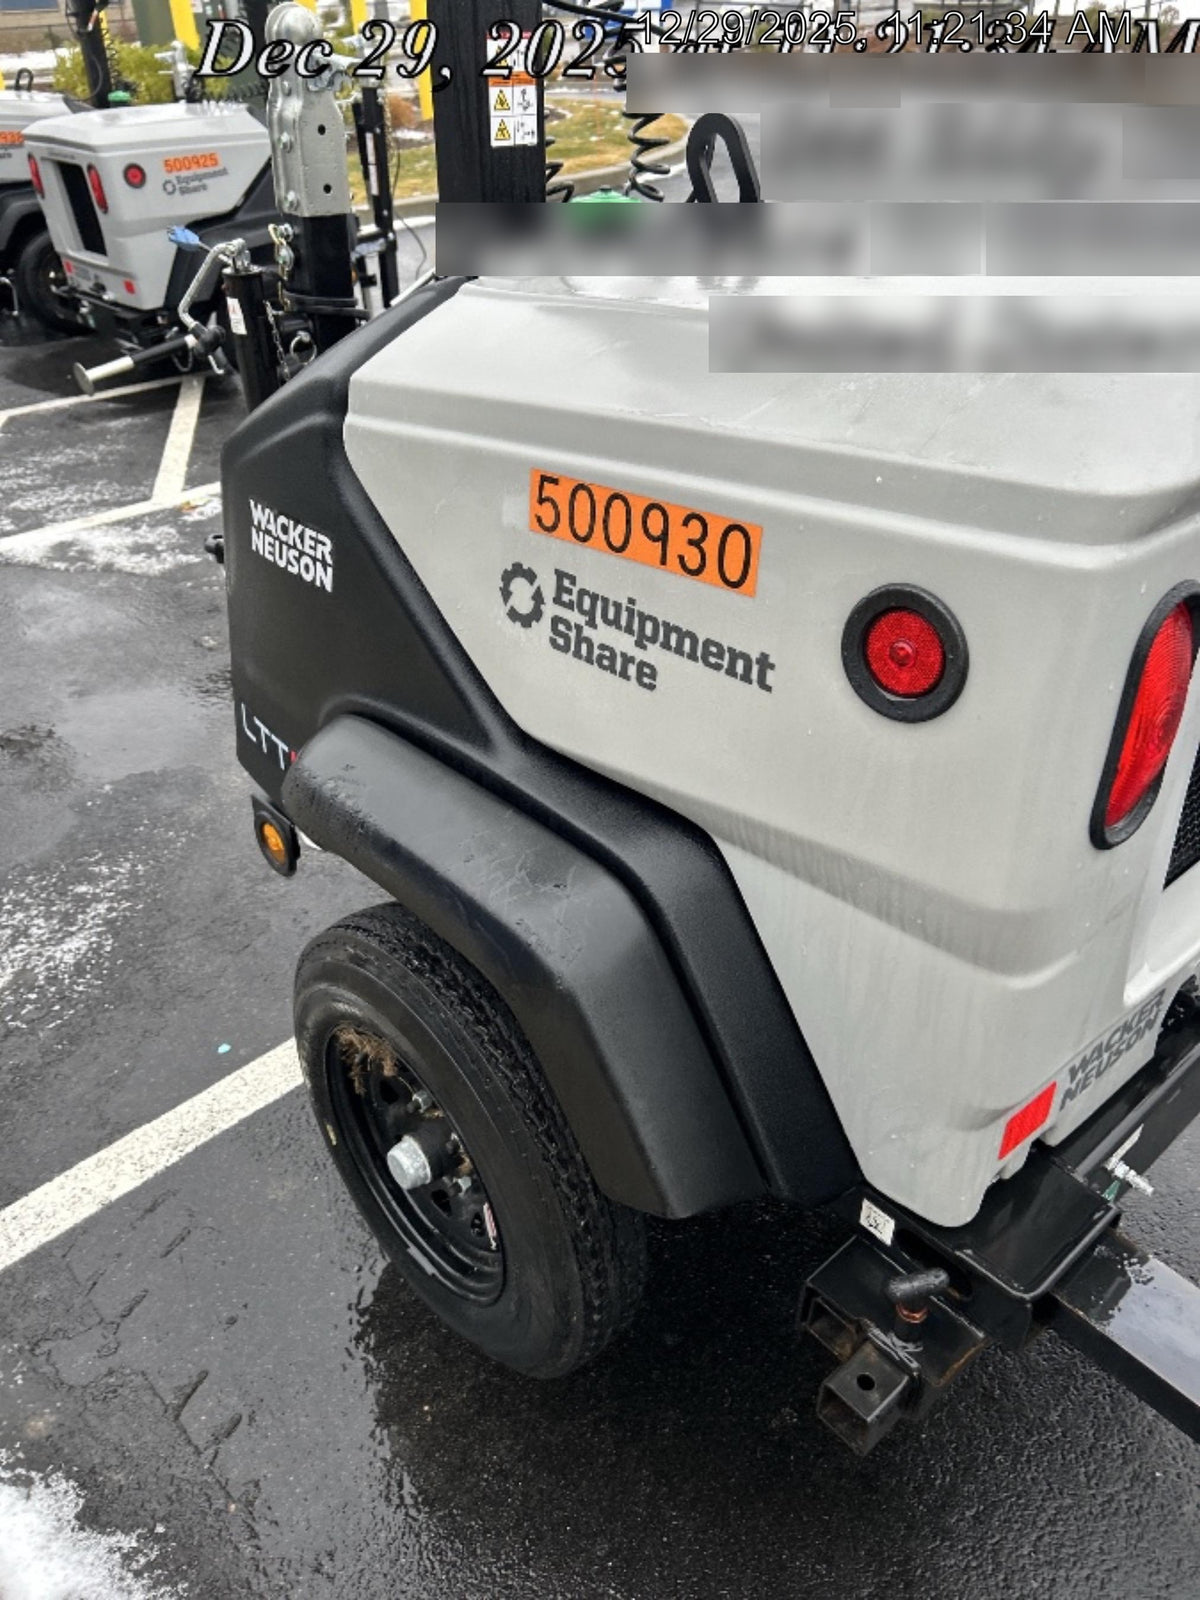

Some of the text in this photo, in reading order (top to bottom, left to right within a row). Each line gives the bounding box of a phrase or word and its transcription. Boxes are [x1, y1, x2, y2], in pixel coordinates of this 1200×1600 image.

[165, 153, 217, 173] 500925
[249, 498, 333, 566] WACKER
[251, 526, 333, 593] NEUSON
[534, 474, 752, 589] 500930
[549, 614, 659, 692] Share
[552, 568, 776, 693] Equipment
[1059, 1006, 1160, 1112] NEUSON
[1069, 988, 1167, 1084] WACKER
